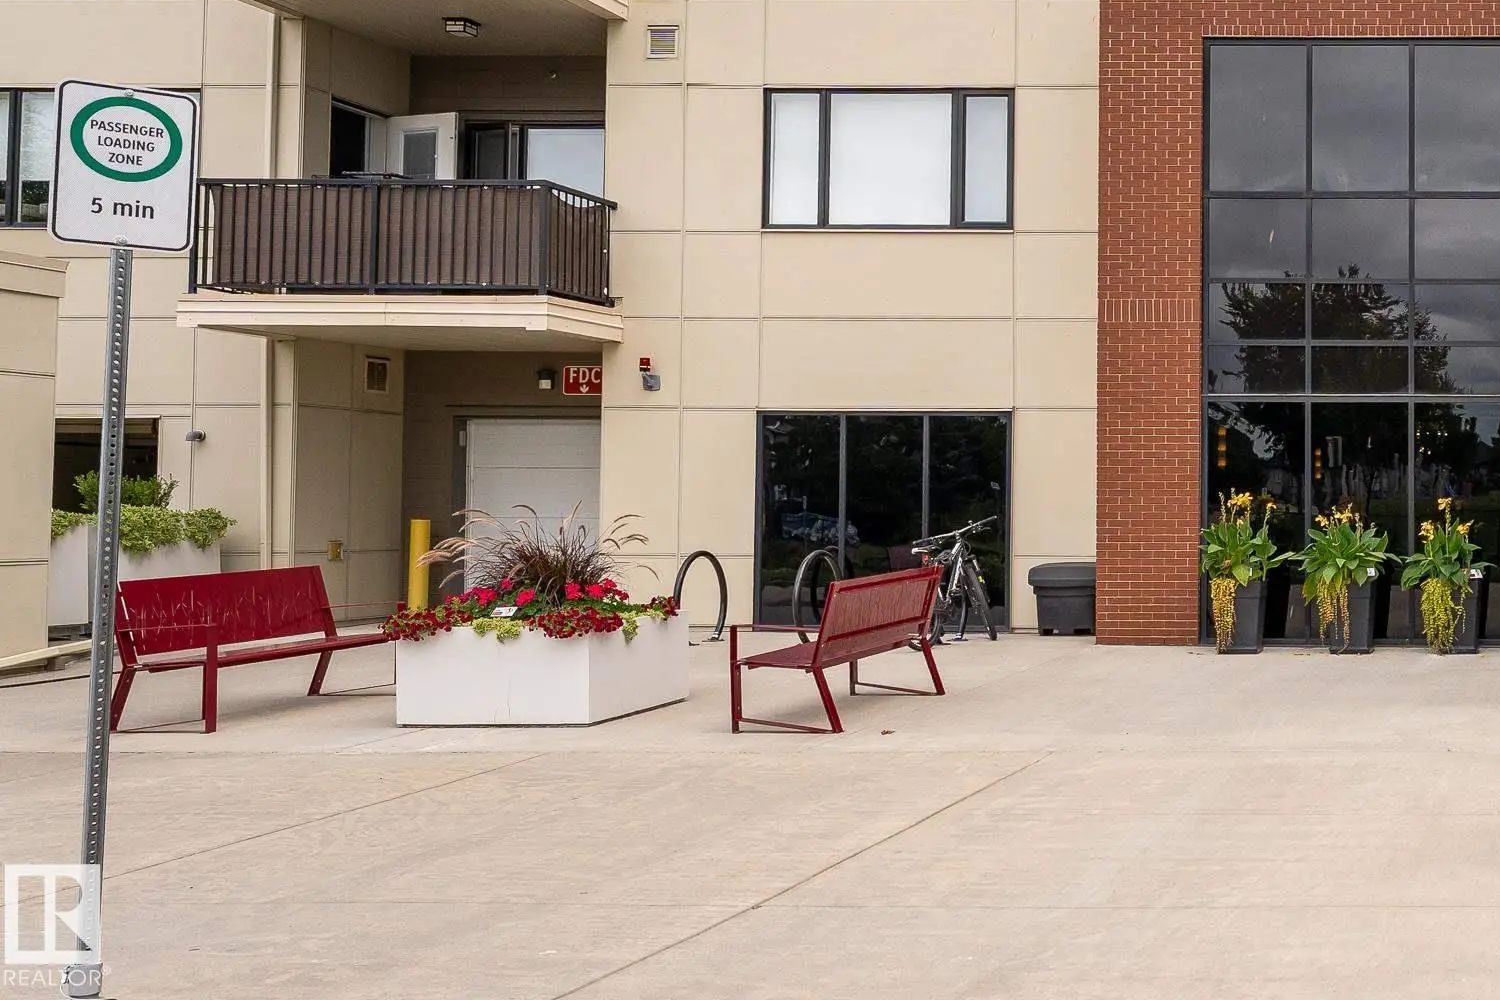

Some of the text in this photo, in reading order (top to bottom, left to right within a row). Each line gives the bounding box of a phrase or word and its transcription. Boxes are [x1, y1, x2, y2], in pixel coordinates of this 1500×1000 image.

[90, 119, 164, 138] PASSENGER
[97, 135, 155, 152] LOADING
[108, 152, 143, 166] ZONE
[90, 197, 155, 219] 5 min
[569, 368, 601, 383] FDC
